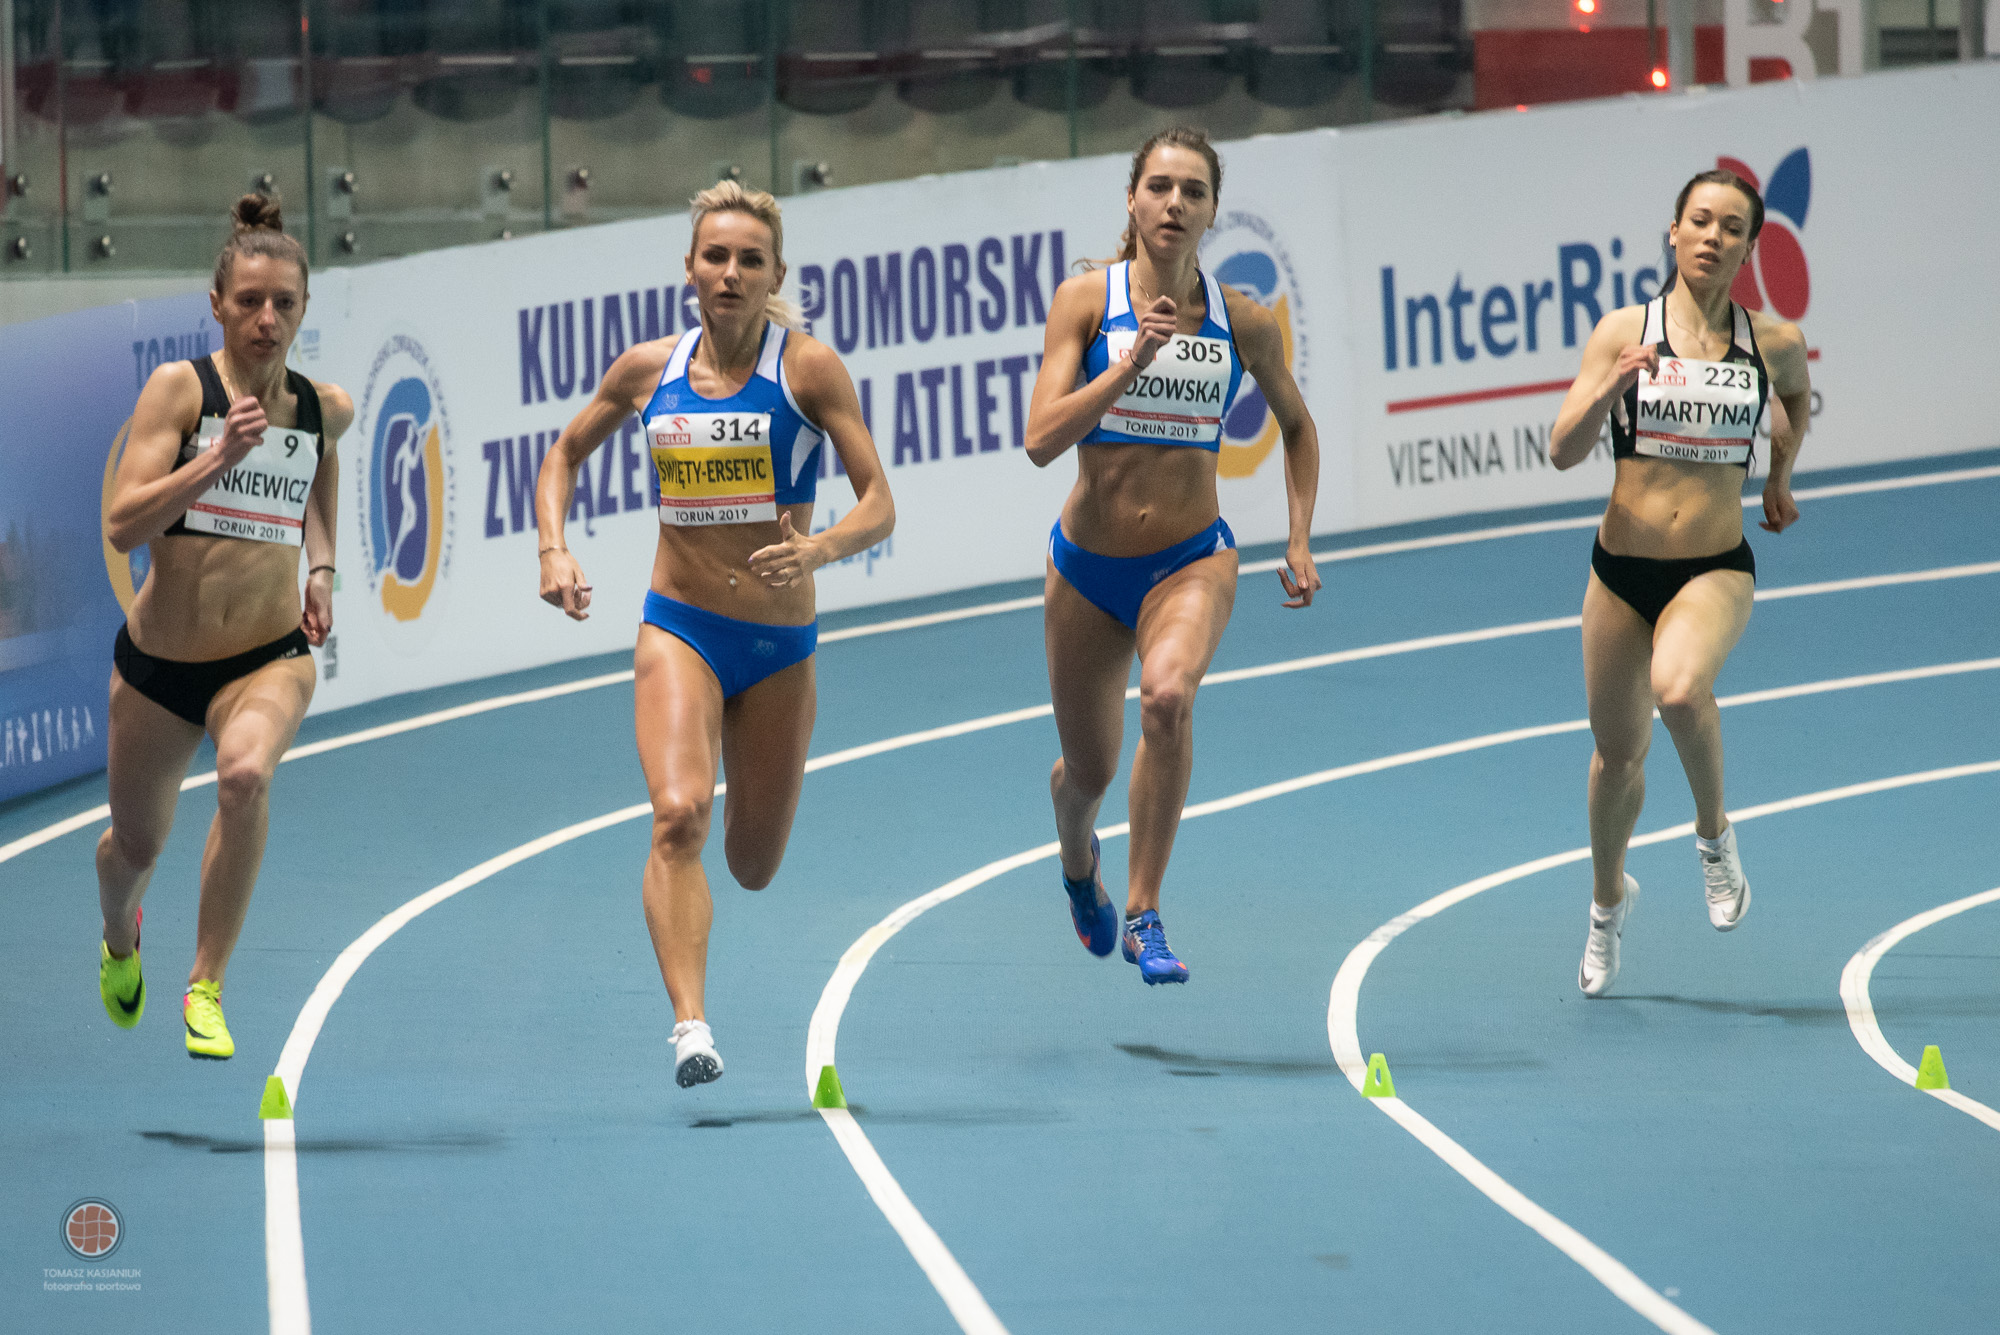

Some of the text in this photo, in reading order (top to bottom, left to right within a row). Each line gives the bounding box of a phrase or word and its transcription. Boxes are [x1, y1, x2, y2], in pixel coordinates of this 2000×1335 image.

[1175, 340, 1223, 364] 305
[1124, 375, 1220, 404] OZOWSKA
[1705, 366, 1752, 390] 223
[892, 352, 1044, 467] ATLET
[1641, 399, 1751, 426] MARTYNA
[657, 418, 761, 446] ORLEN 314
[1125, 418, 1199, 438] TORUŃ 2019
[284, 434, 299, 459] 9
[1387, 430, 1504, 487] VIENNA
[1660, 444, 1728, 460] TORUŃ 2019
[658, 455, 767, 489] ŚWIĘTY-ERSETIC
[214, 467, 309, 504] NKIEWICZ
[675, 507, 749, 522] TORUŃ 2019
[213, 518, 286, 540] TORUŃ 2019
